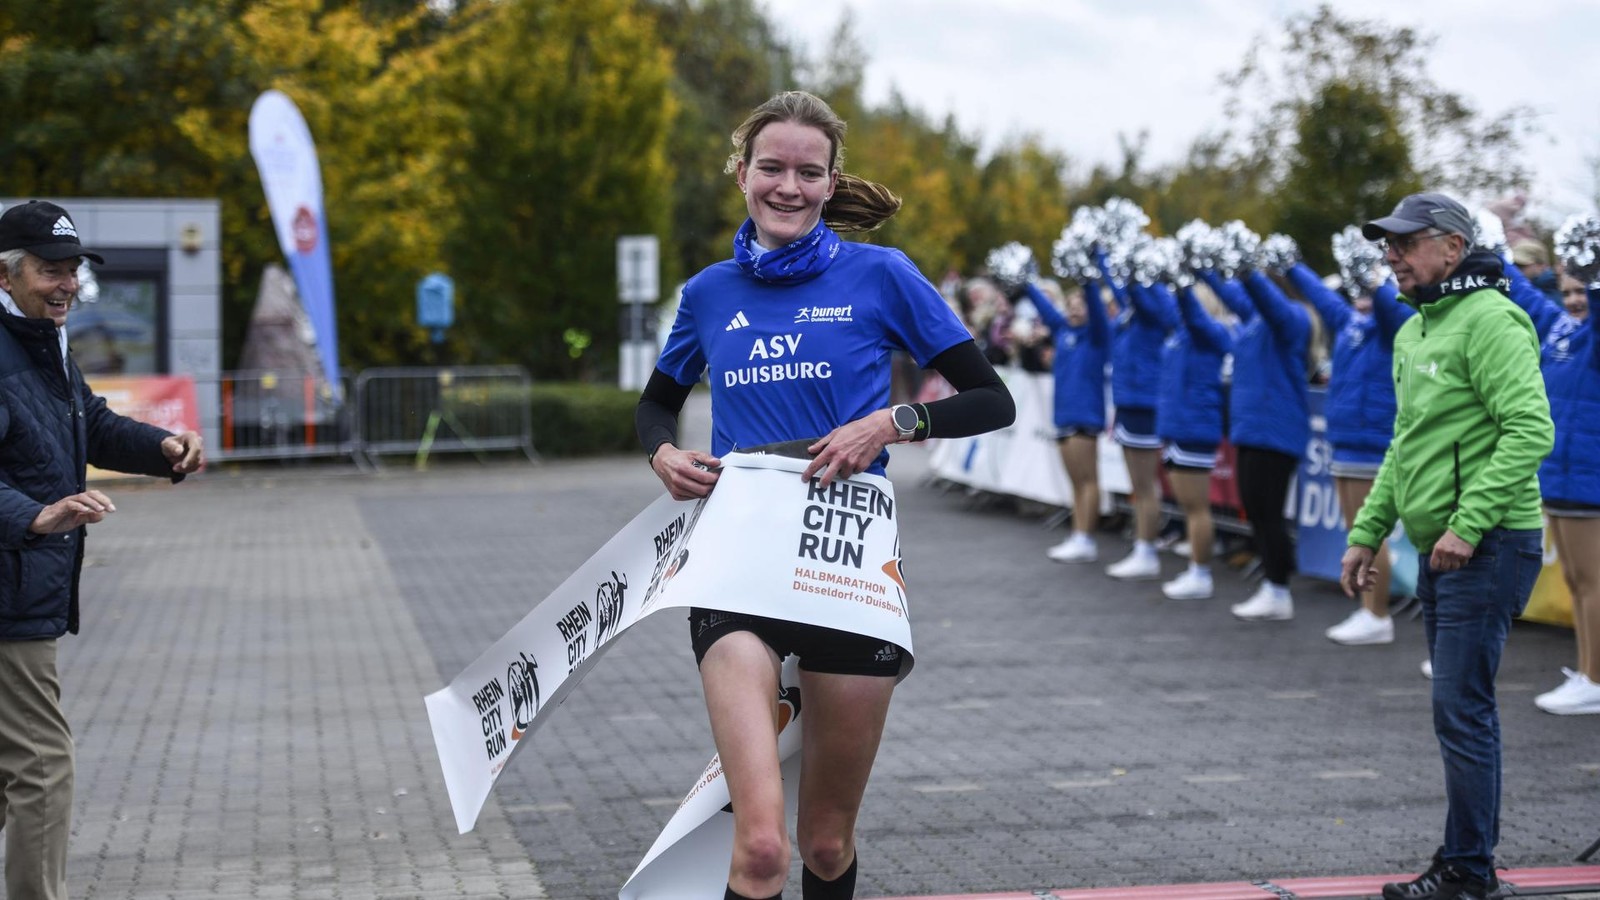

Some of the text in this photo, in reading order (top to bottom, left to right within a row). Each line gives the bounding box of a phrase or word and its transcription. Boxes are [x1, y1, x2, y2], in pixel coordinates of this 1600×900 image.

[1440, 275, 1489, 294] PEAK
[811, 304, 853, 317] bunert
[748, 333, 803, 361] ASV
[724, 361, 832, 388] DUISBURG
[807, 476, 893, 520] RHEIN
[654, 512, 686, 560] RHEIN
[803, 504, 874, 541] CITY
[798, 532, 864, 569] RUN
[794, 567, 886, 595] HALBMARATHON
[556, 600, 592, 643] RHEIN
[567, 630, 587, 667] CITY
[472, 677, 504, 715] RHEIN
[481, 704, 503, 738] CITY
[485, 729, 507, 761] RUN
